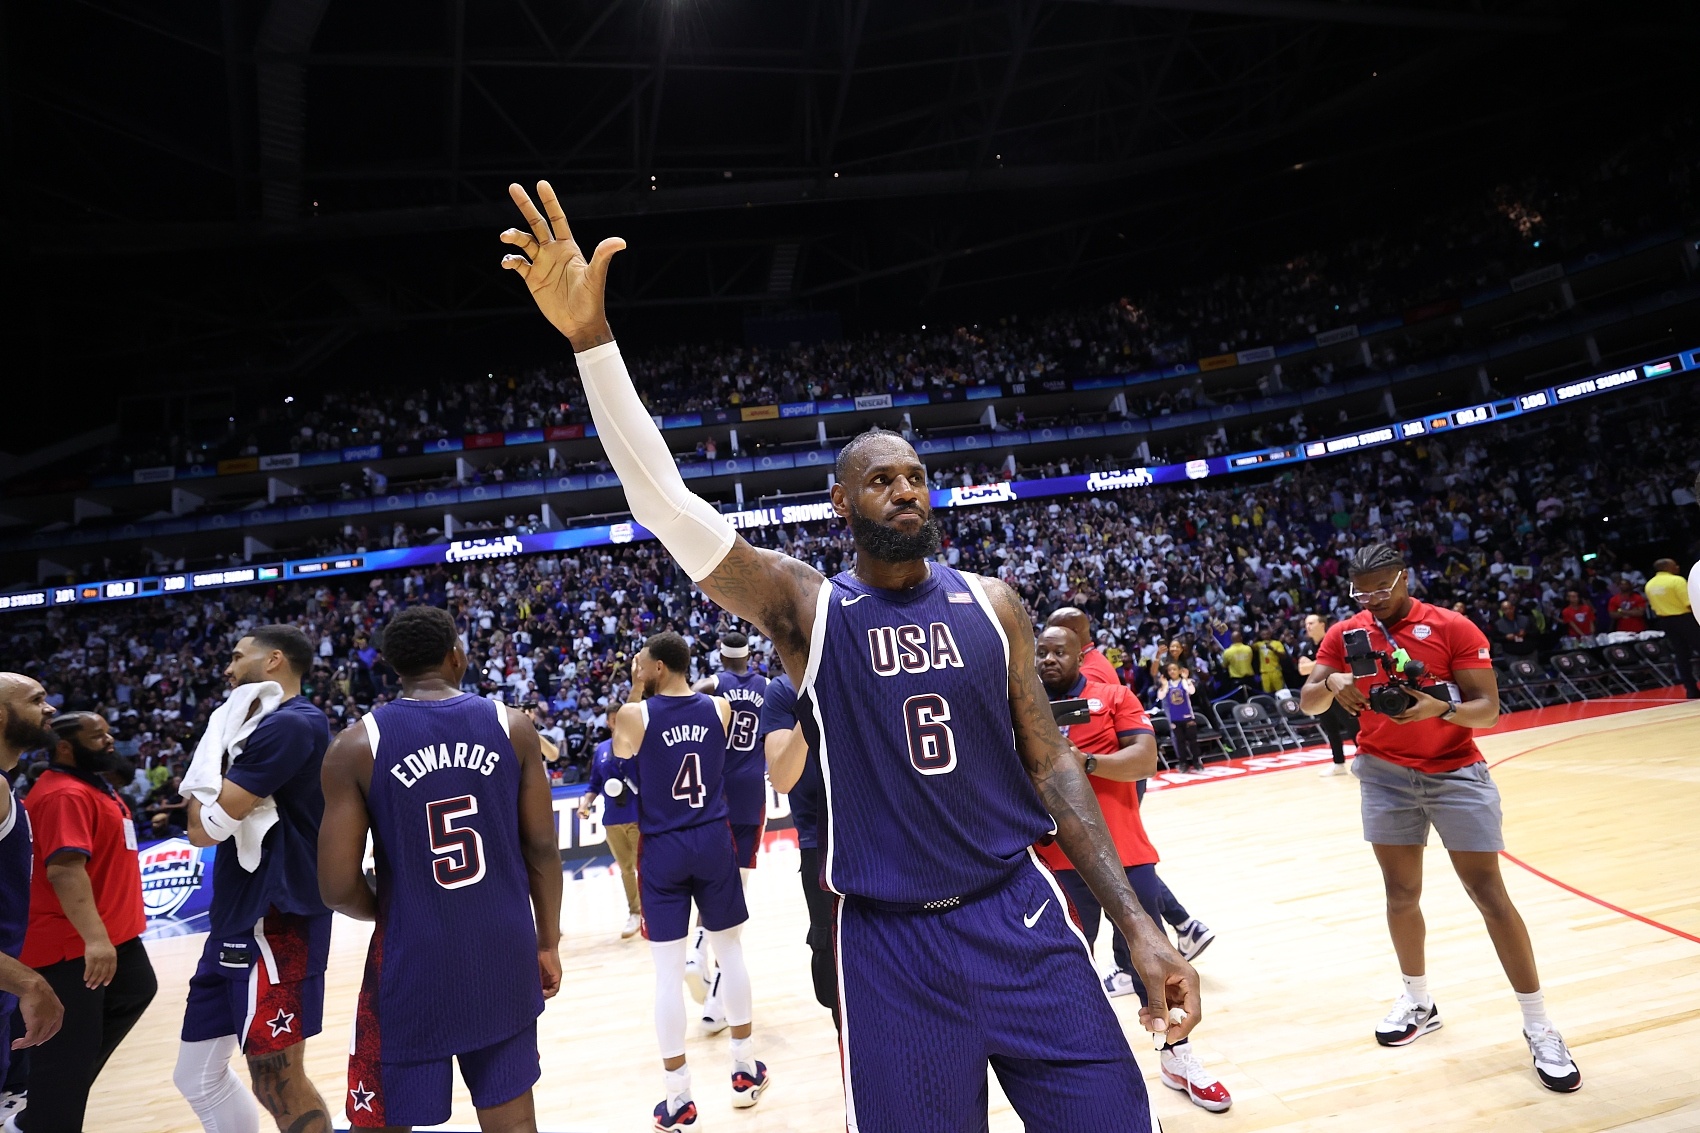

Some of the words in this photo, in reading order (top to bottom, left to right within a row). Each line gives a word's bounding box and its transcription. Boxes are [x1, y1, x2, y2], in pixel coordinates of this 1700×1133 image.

[1557, 380, 1596, 399] SOUTH
[1596, 369, 1638, 389] SUDAN
[783, 402, 814, 416] gopuff
[868, 622, 964, 677] USA
[723, 689, 764, 708] ADEBAYO
[662, 725, 709, 747] CURRY
[903, 693, 958, 775] 6
[390, 742, 500, 788] EDWARDS
[672, 752, 706, 808] 4
[426, 794, 486, 890] 5
[142, 849, 191, 876] USA
